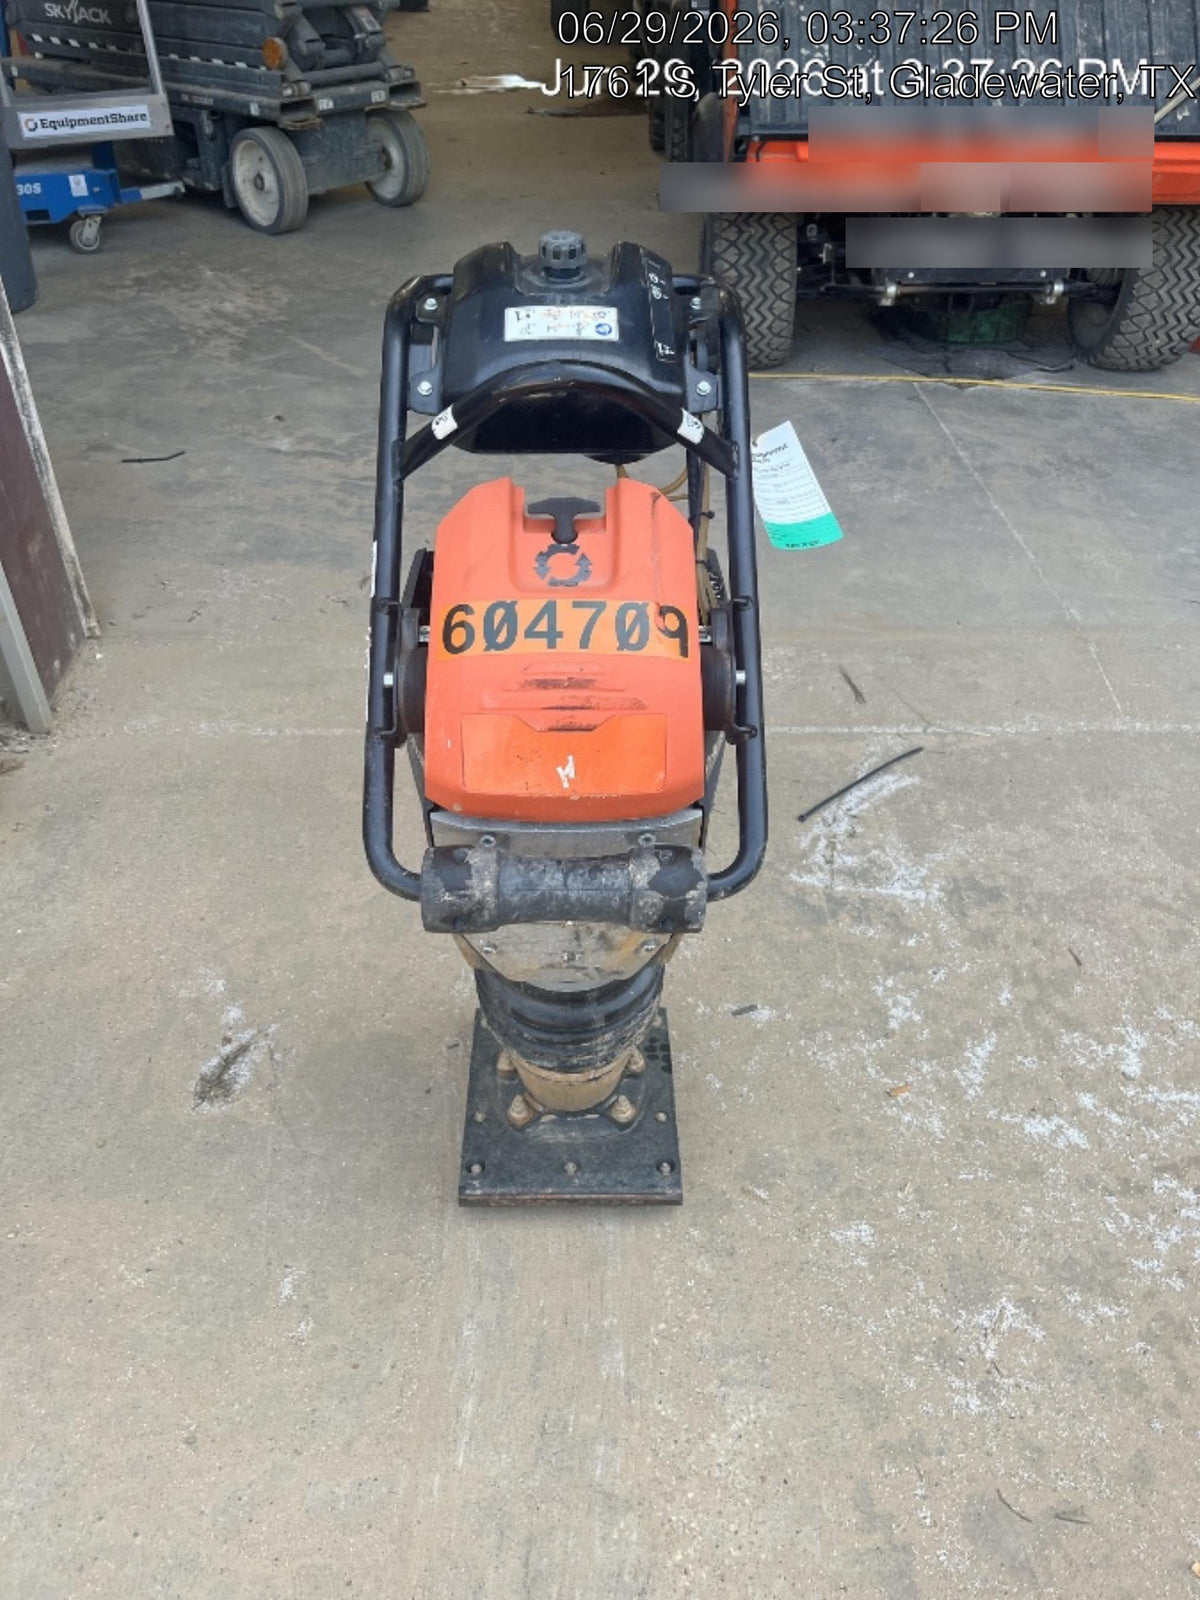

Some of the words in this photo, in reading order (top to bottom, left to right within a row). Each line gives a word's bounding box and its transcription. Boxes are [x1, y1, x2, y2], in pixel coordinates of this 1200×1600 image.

[44, 0, 112, 25] SKYJACK
[40, 113, 147, 130] EquipmentShare
[442, 600, 688, 658] 604709
